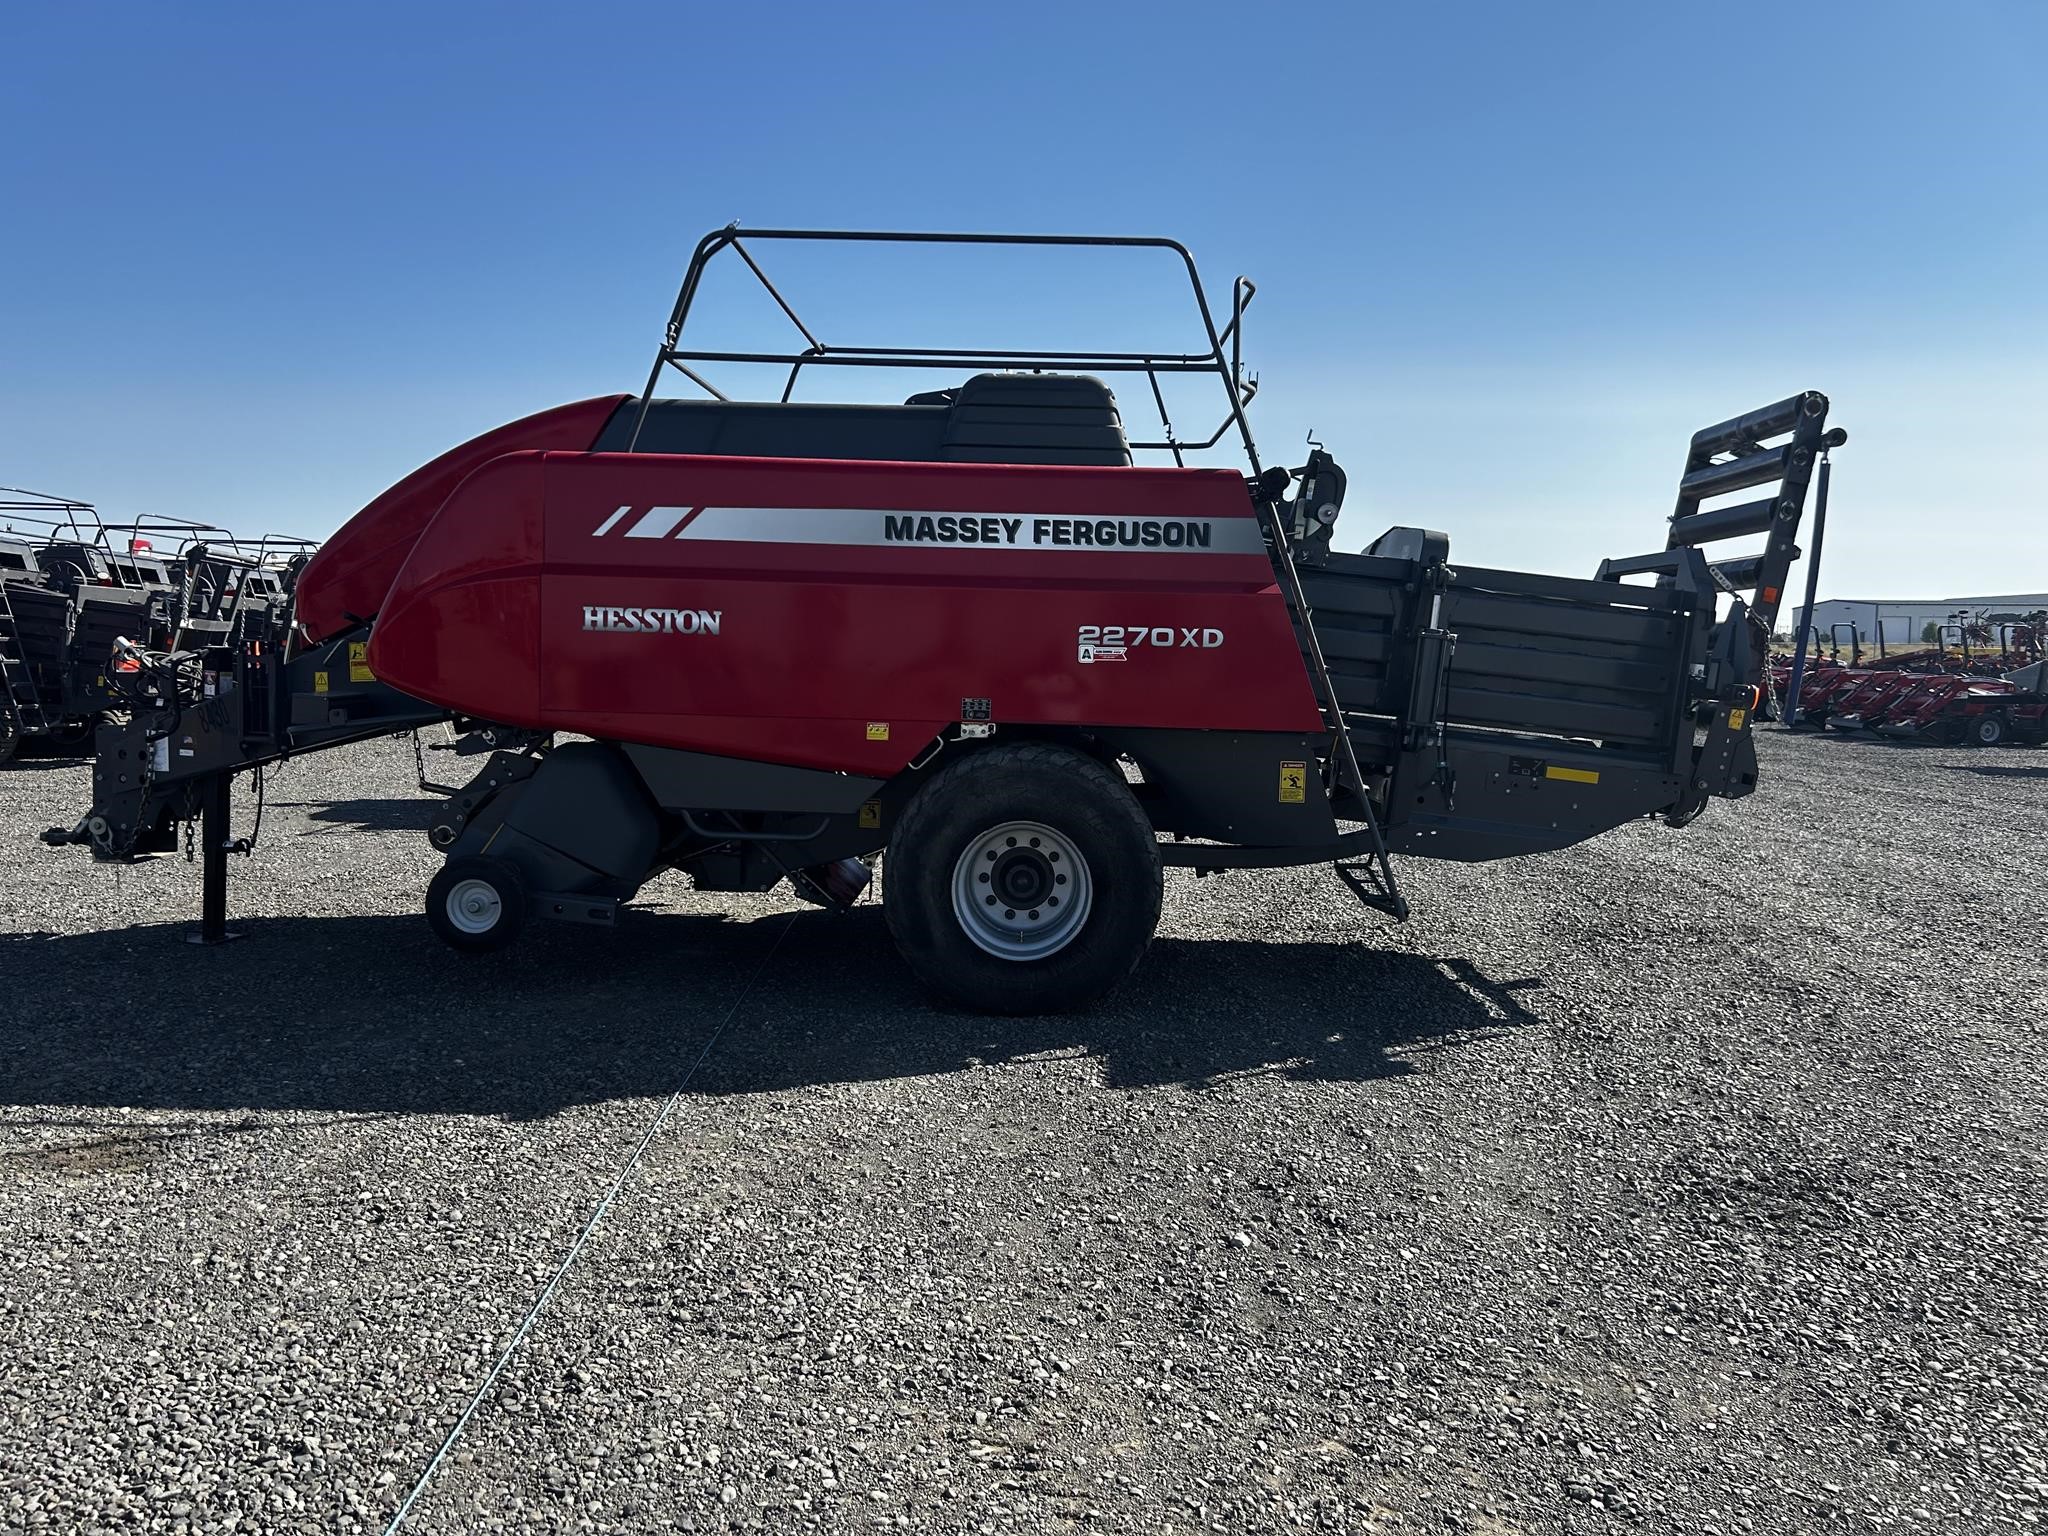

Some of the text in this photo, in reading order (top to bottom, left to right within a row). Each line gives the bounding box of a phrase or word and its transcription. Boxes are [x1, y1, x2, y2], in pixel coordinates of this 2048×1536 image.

[884, 515, 1211, 547] MASSEY FERGUSON
[582, 606, 722, 635] HESSTON
[1078, 625, 1224, 648] 2270 XD
